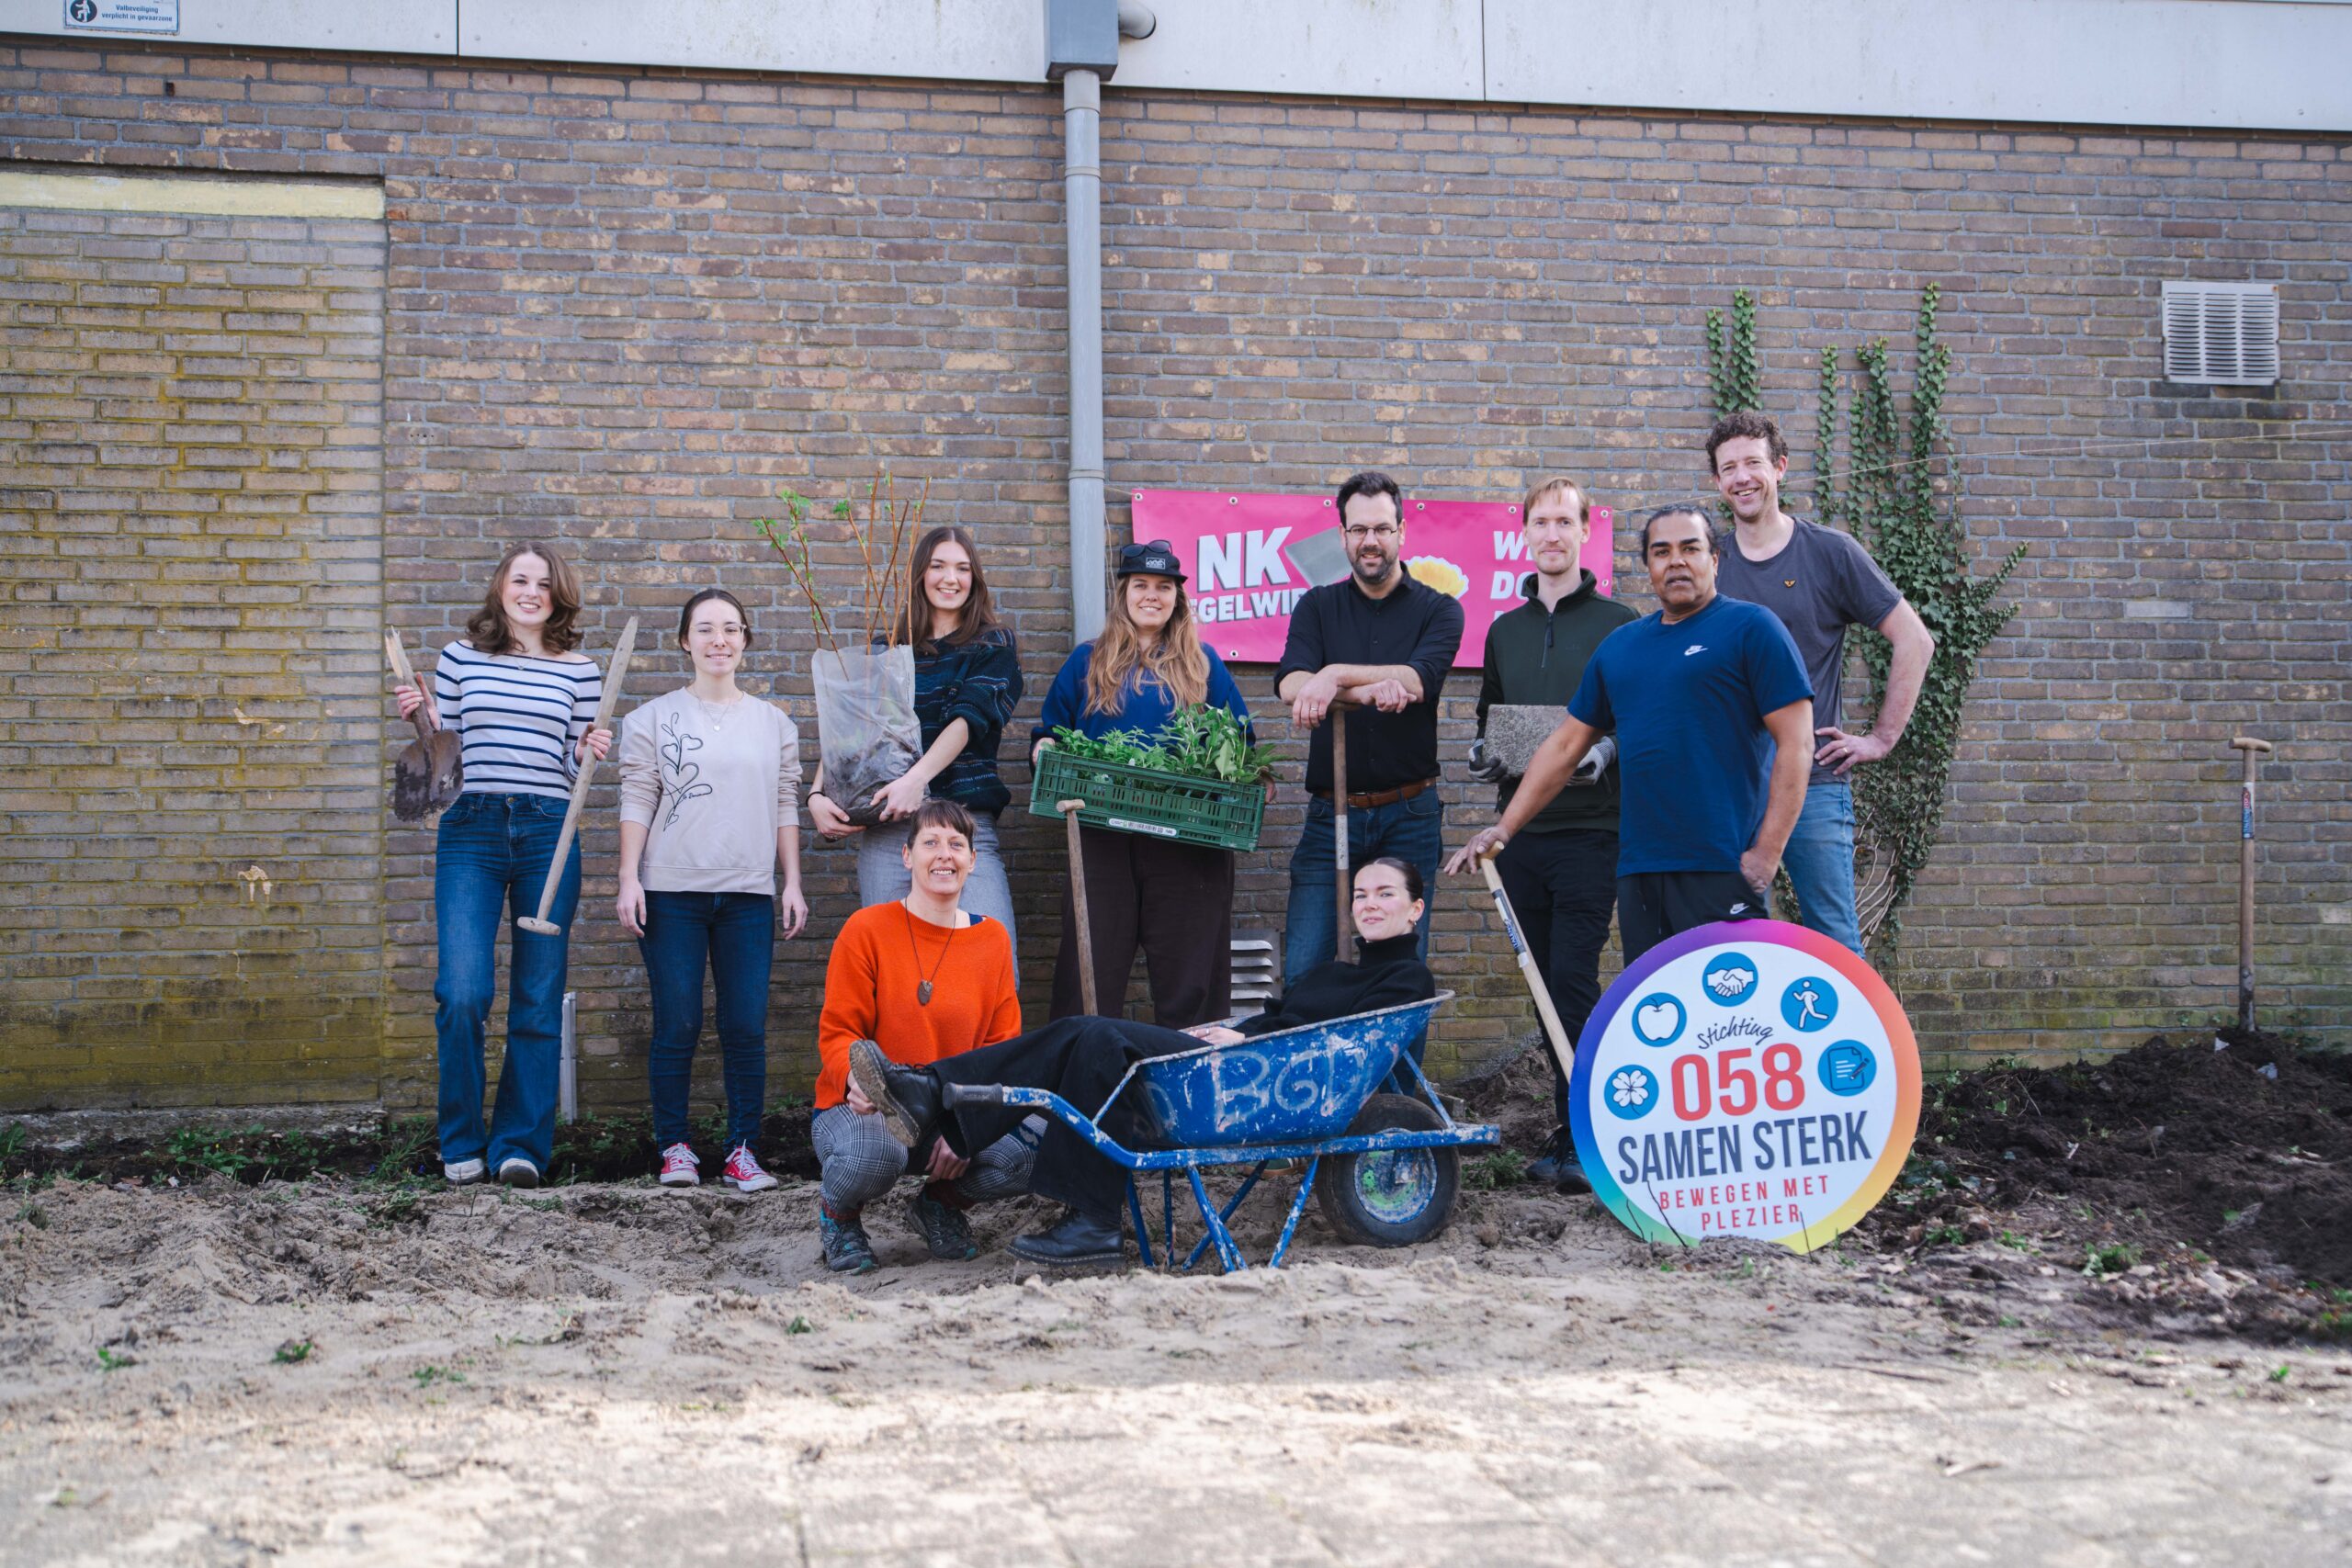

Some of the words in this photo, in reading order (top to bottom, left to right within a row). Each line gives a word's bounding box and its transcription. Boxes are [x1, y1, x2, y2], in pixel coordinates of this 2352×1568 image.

[116, 5, 158, 14] Valbeveiliging
[1197, 526, 1293, 593] NK
[1697, 1016, 1775, 1049] Stichting
[1671, 1043, 1805, 1122] 058
[1618, 1124, 1743, 1185] SAMEN
[1753, 1111, 1872, 1170] STERK
[1660, 1181, 1768, 1210] BEWEGEN
[1784, 1176, 1829, 1198] MET
[1702, 1204, 1802, 1231] PLEZIER
